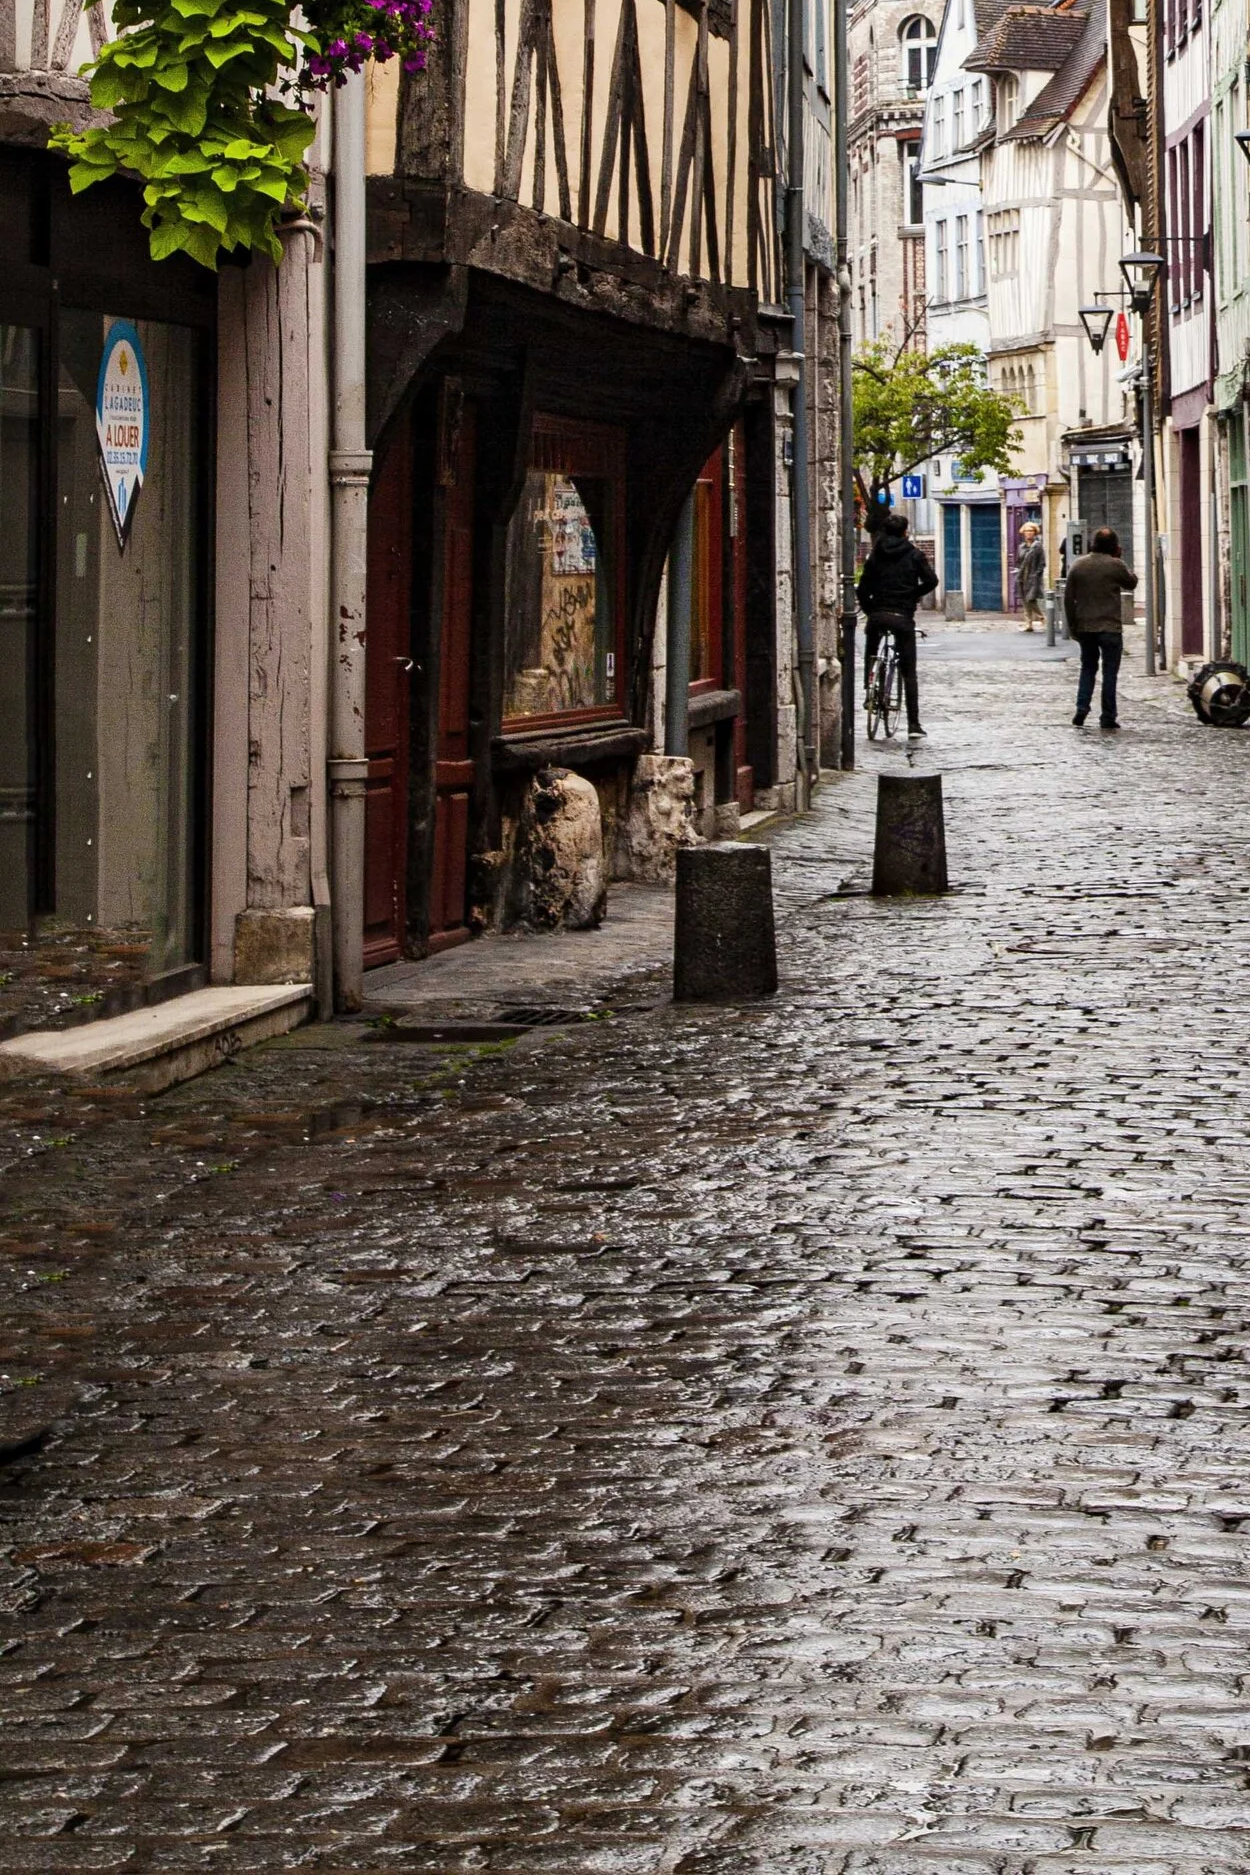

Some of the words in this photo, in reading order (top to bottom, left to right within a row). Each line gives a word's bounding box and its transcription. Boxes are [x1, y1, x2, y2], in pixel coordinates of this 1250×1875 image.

[105, 396, 141, 412] LAGADEUC
[106, 424, 112, 447] A
[114, 425, 139, 447] LOUER
